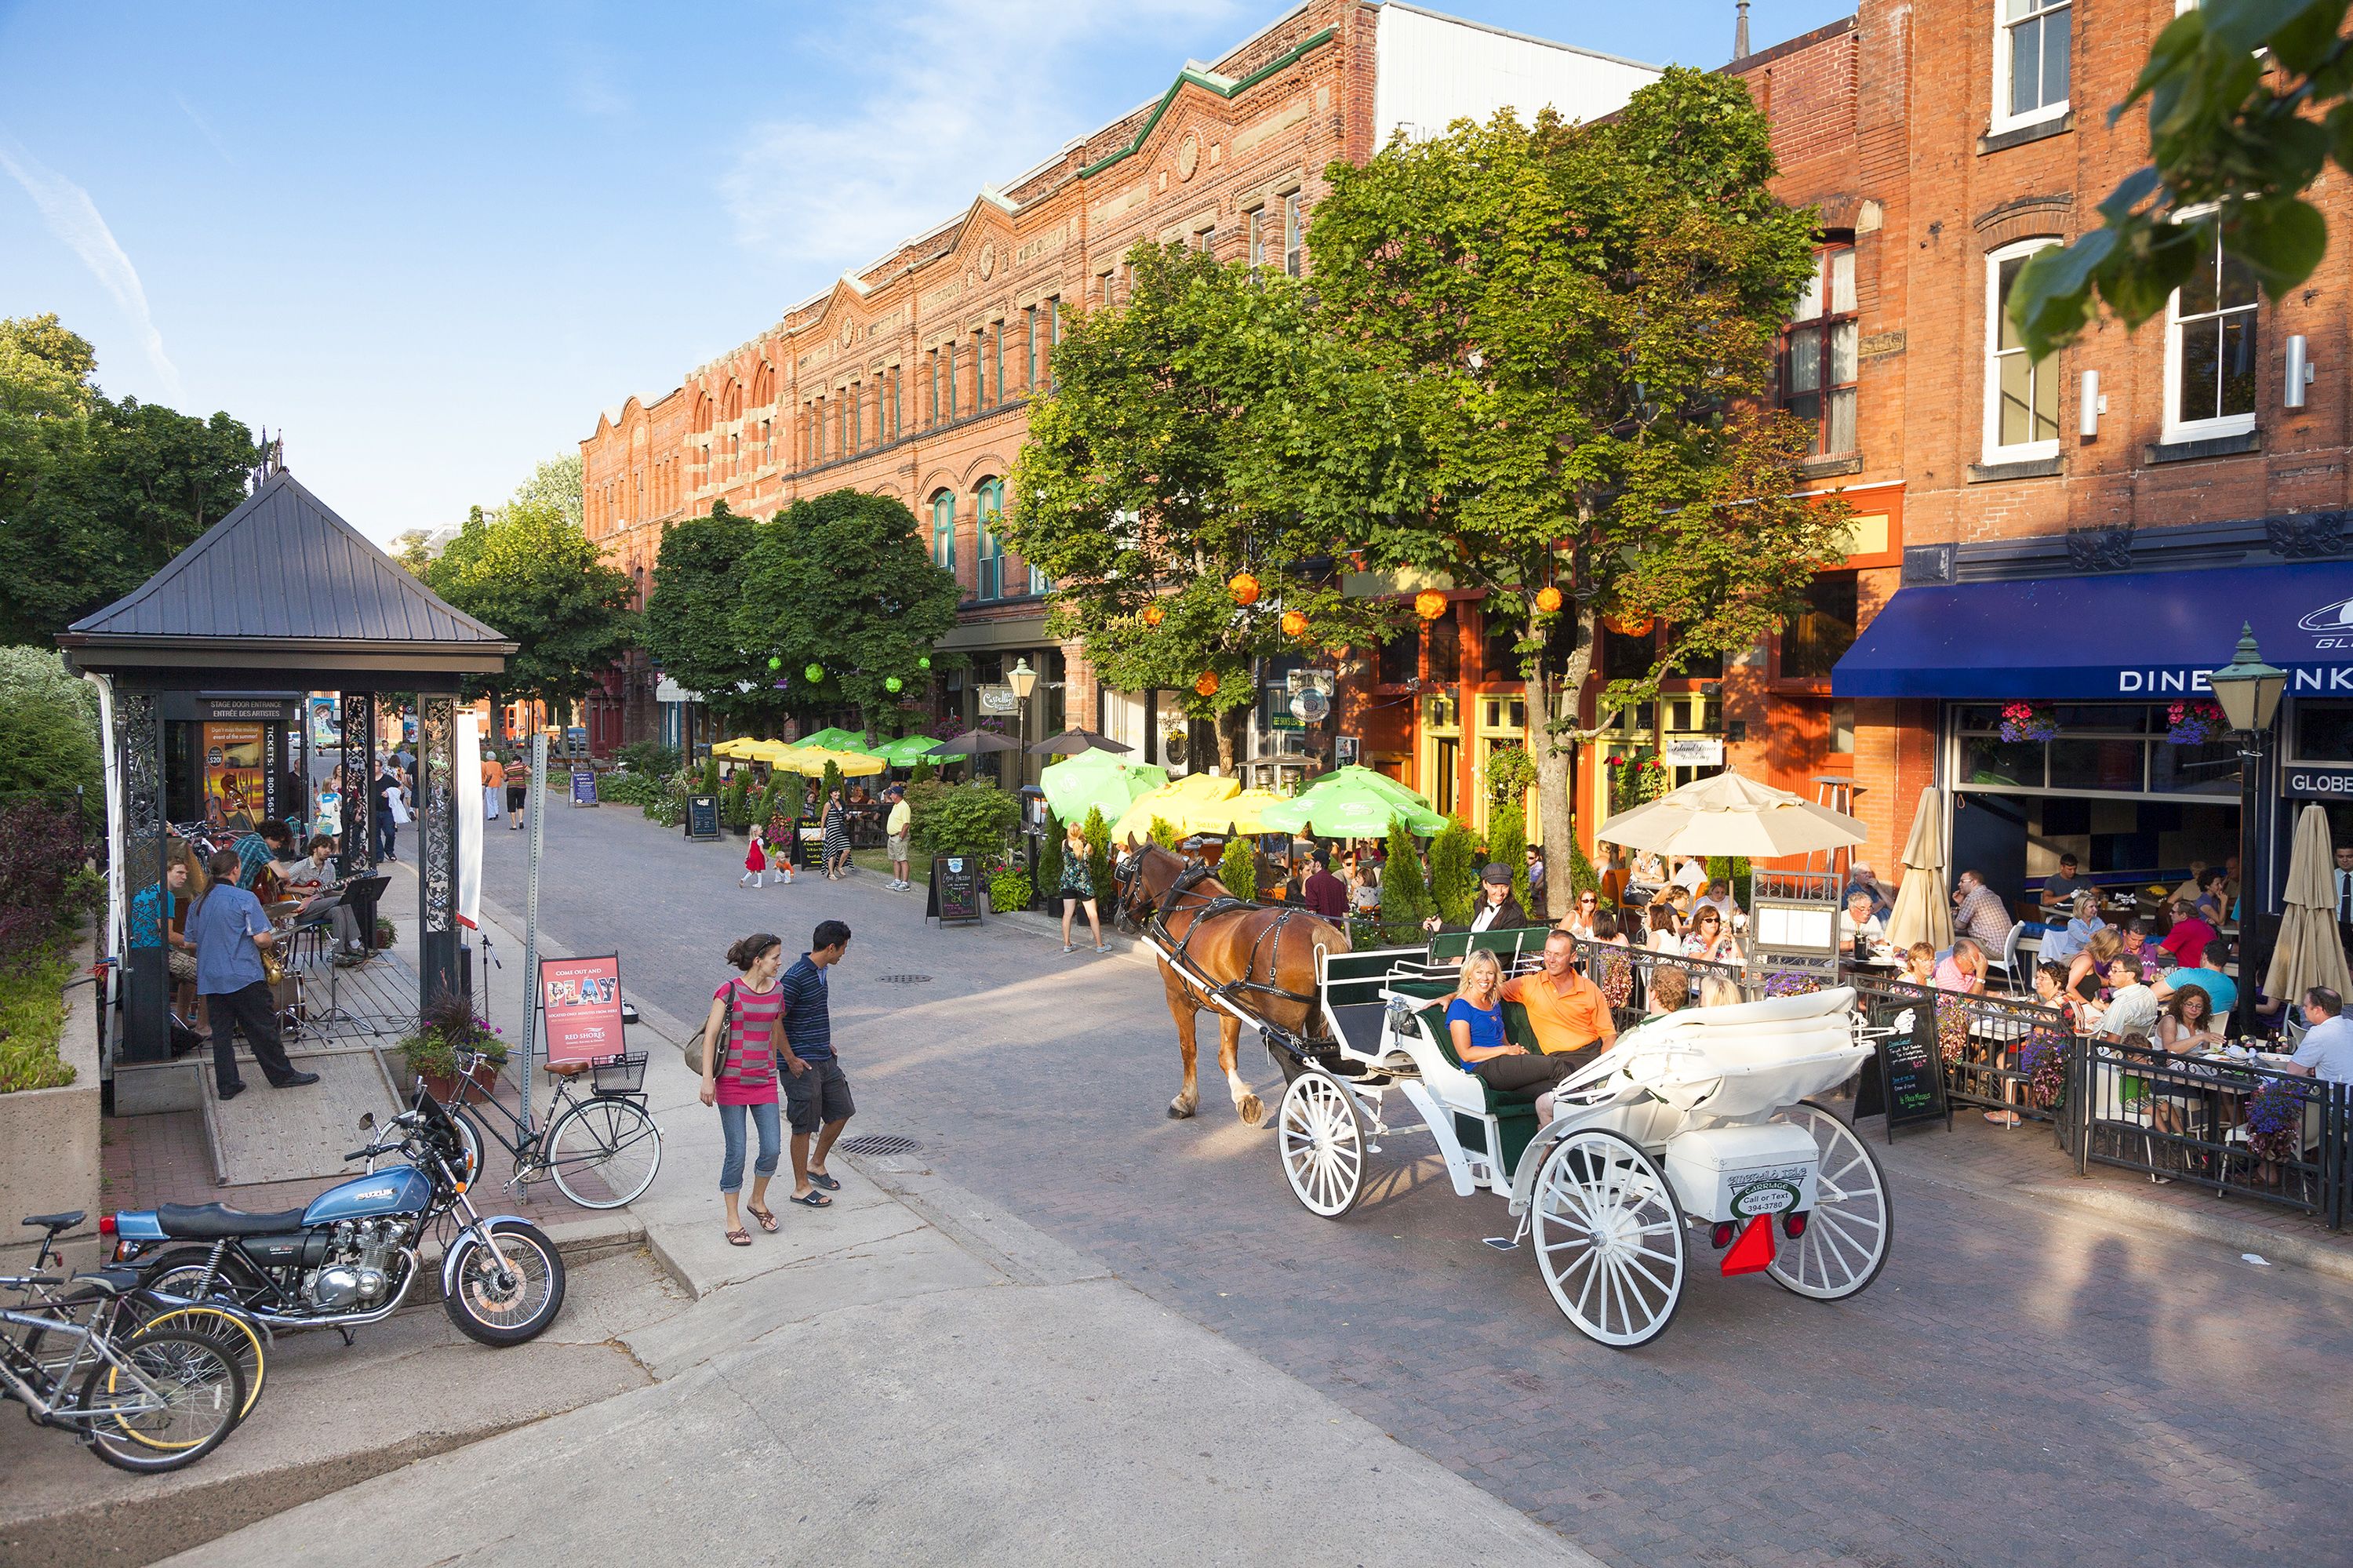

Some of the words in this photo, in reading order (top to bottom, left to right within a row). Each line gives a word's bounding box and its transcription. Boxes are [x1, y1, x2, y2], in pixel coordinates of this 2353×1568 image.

[2315, 638, 2353, 649] GL
[2119, 670, 2213, 692] DINE
[1671, 744, 1695, 752] Island
[2292, 774, 2353, 792] GLOBE
[547, 977, 618, 1008] PLAY
[1744, 1195, 1759, 1204] Call
[1747, 1202, 1783, 1212] 394-3780
